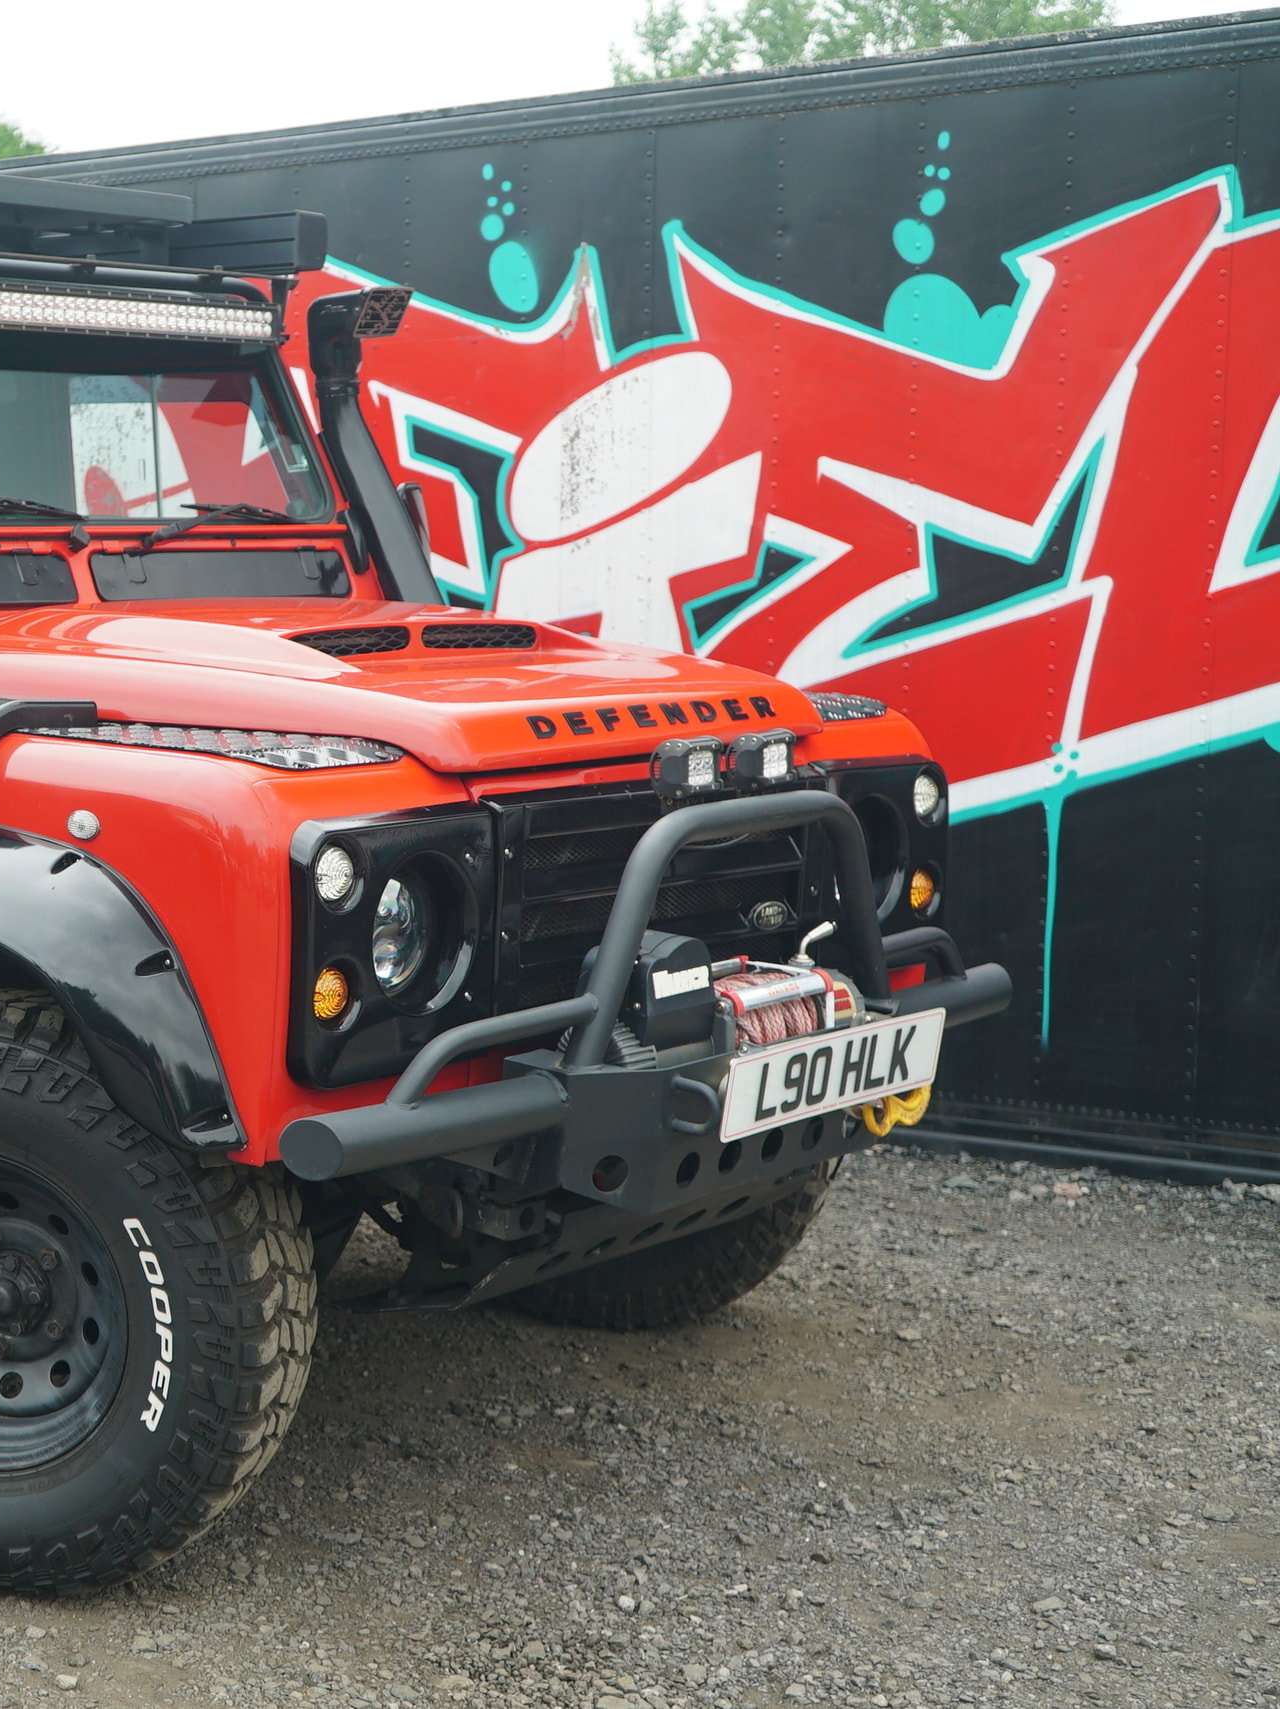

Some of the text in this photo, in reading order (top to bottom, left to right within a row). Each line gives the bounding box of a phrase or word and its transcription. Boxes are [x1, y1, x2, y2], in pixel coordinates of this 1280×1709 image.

[526, 695, 777, 739] DEFENDER
[754, 1024, 917, 1122] L90 HLK
[123, 1217, 173, 1432] COOPER
